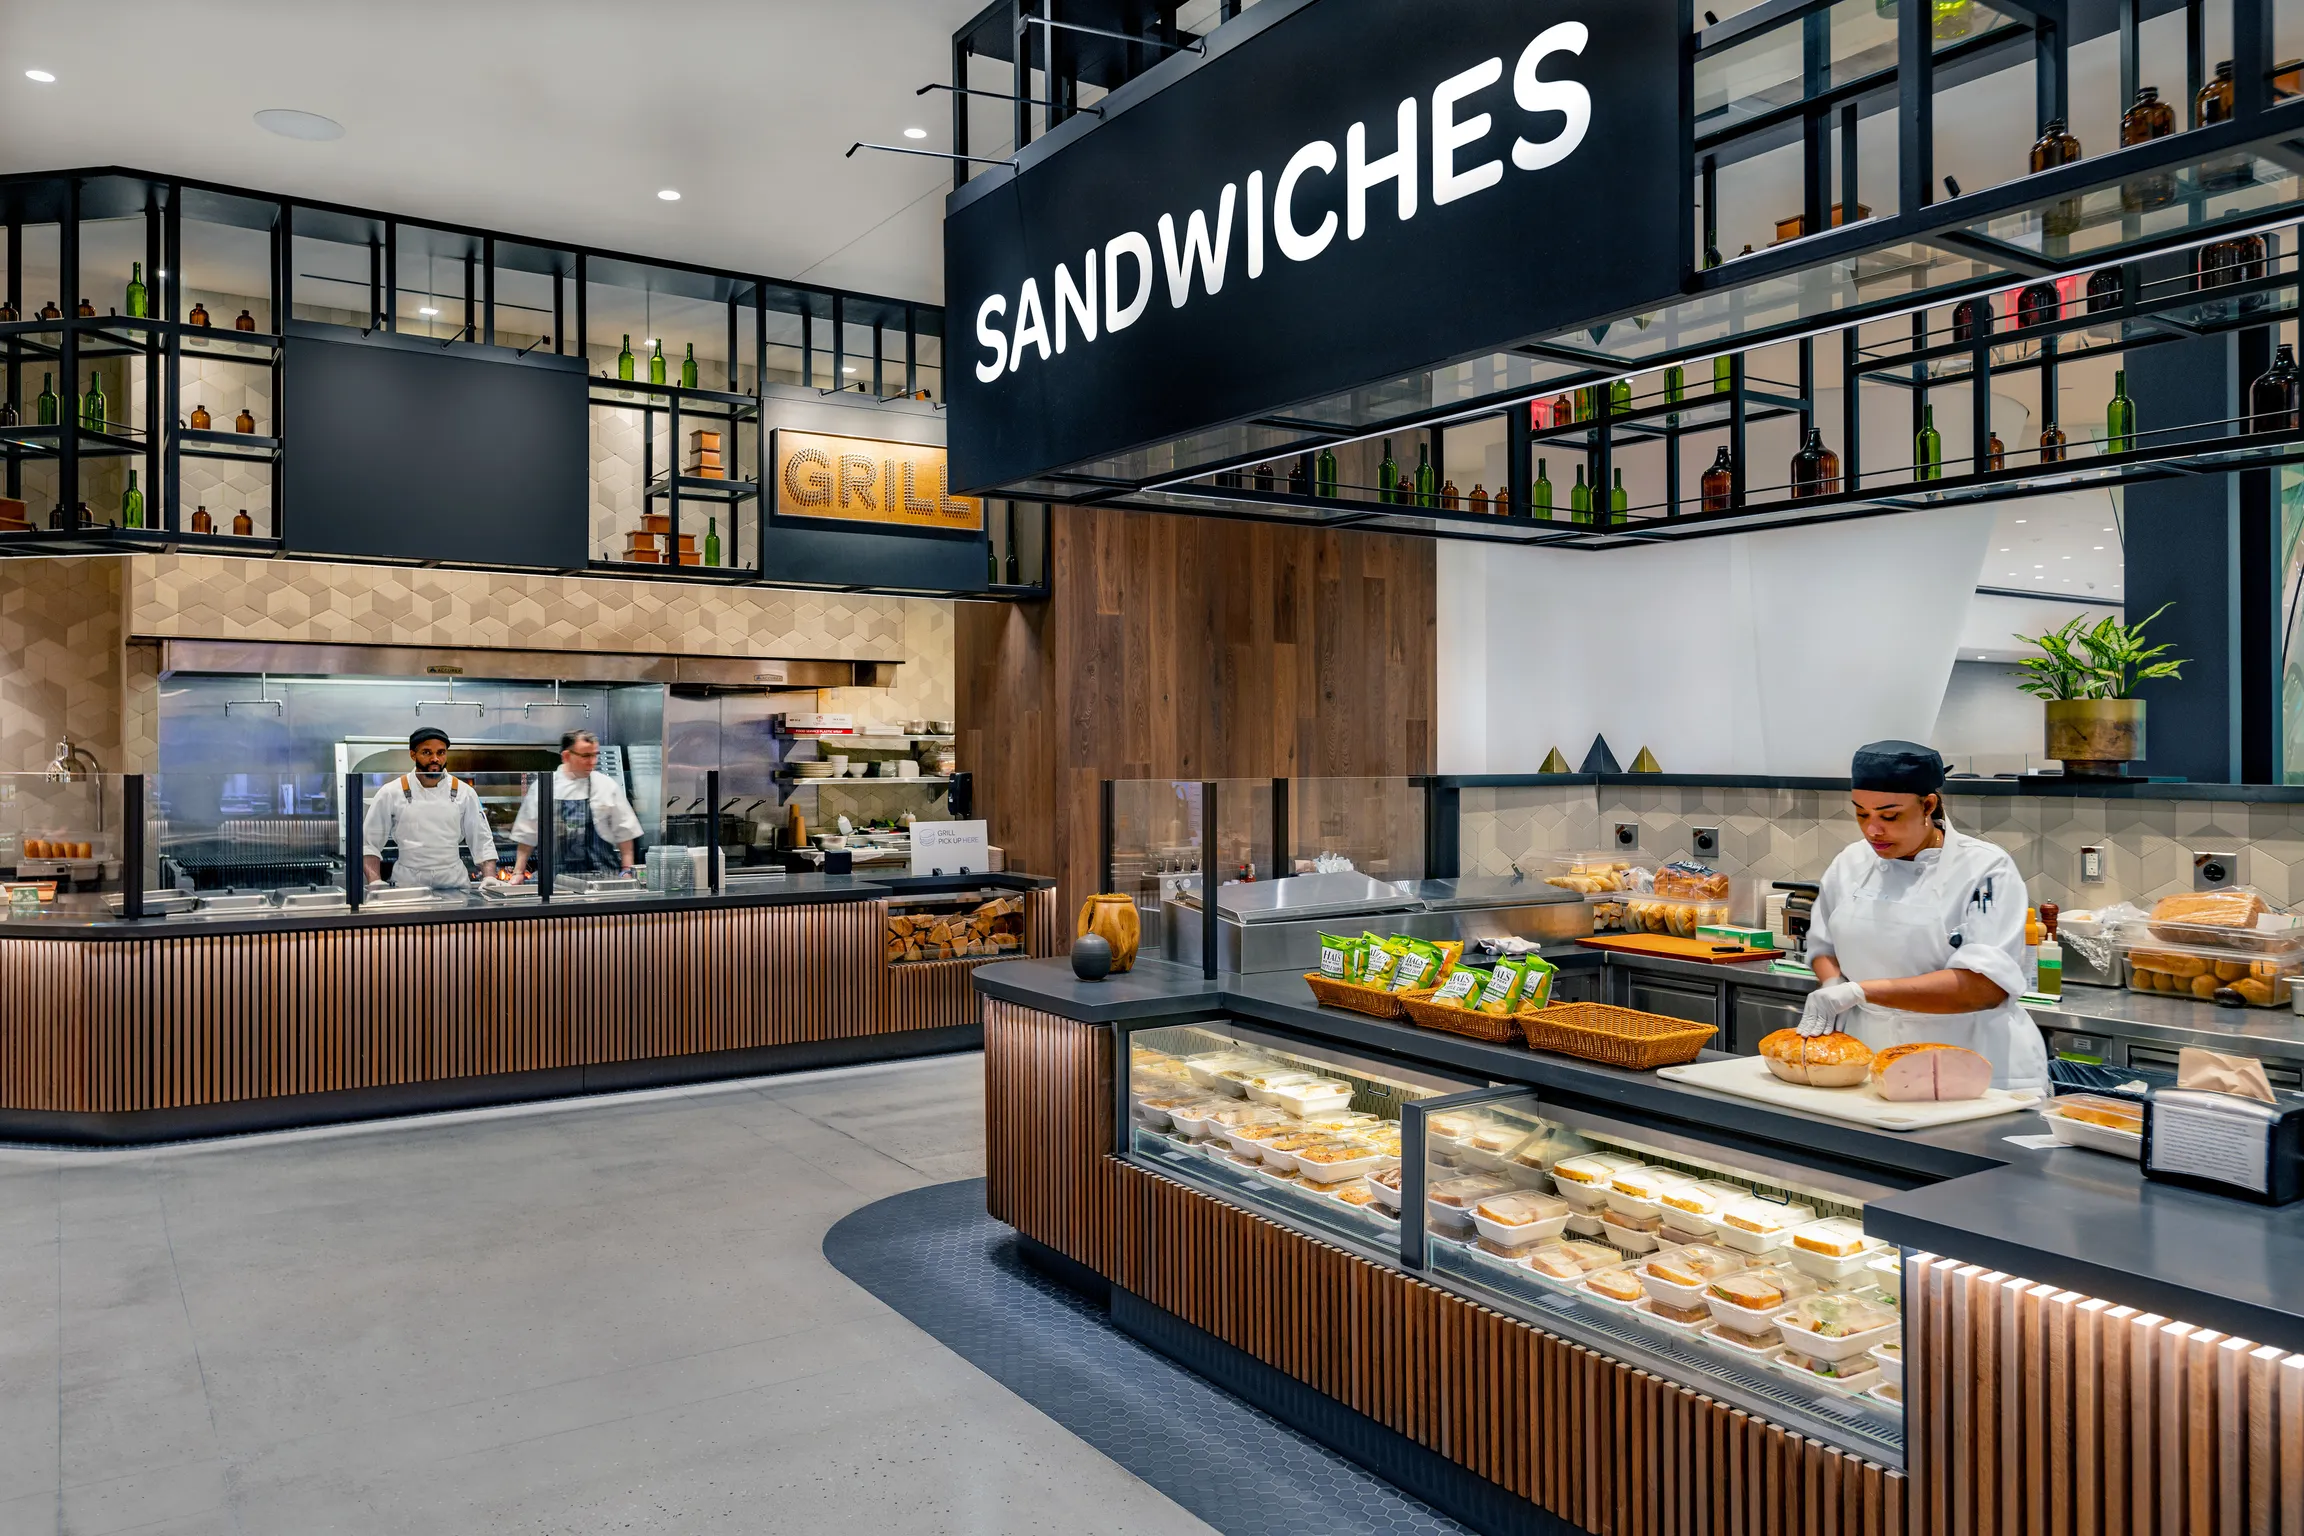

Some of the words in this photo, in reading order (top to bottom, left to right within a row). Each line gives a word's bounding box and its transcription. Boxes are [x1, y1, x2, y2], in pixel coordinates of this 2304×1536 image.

[975, 20, 1592, 384] SANDWICHES
[784, 447, 971, 519] GRILL
[937, 829, 956, 837] GRILL
[962, 836, 979, 844] HERE
